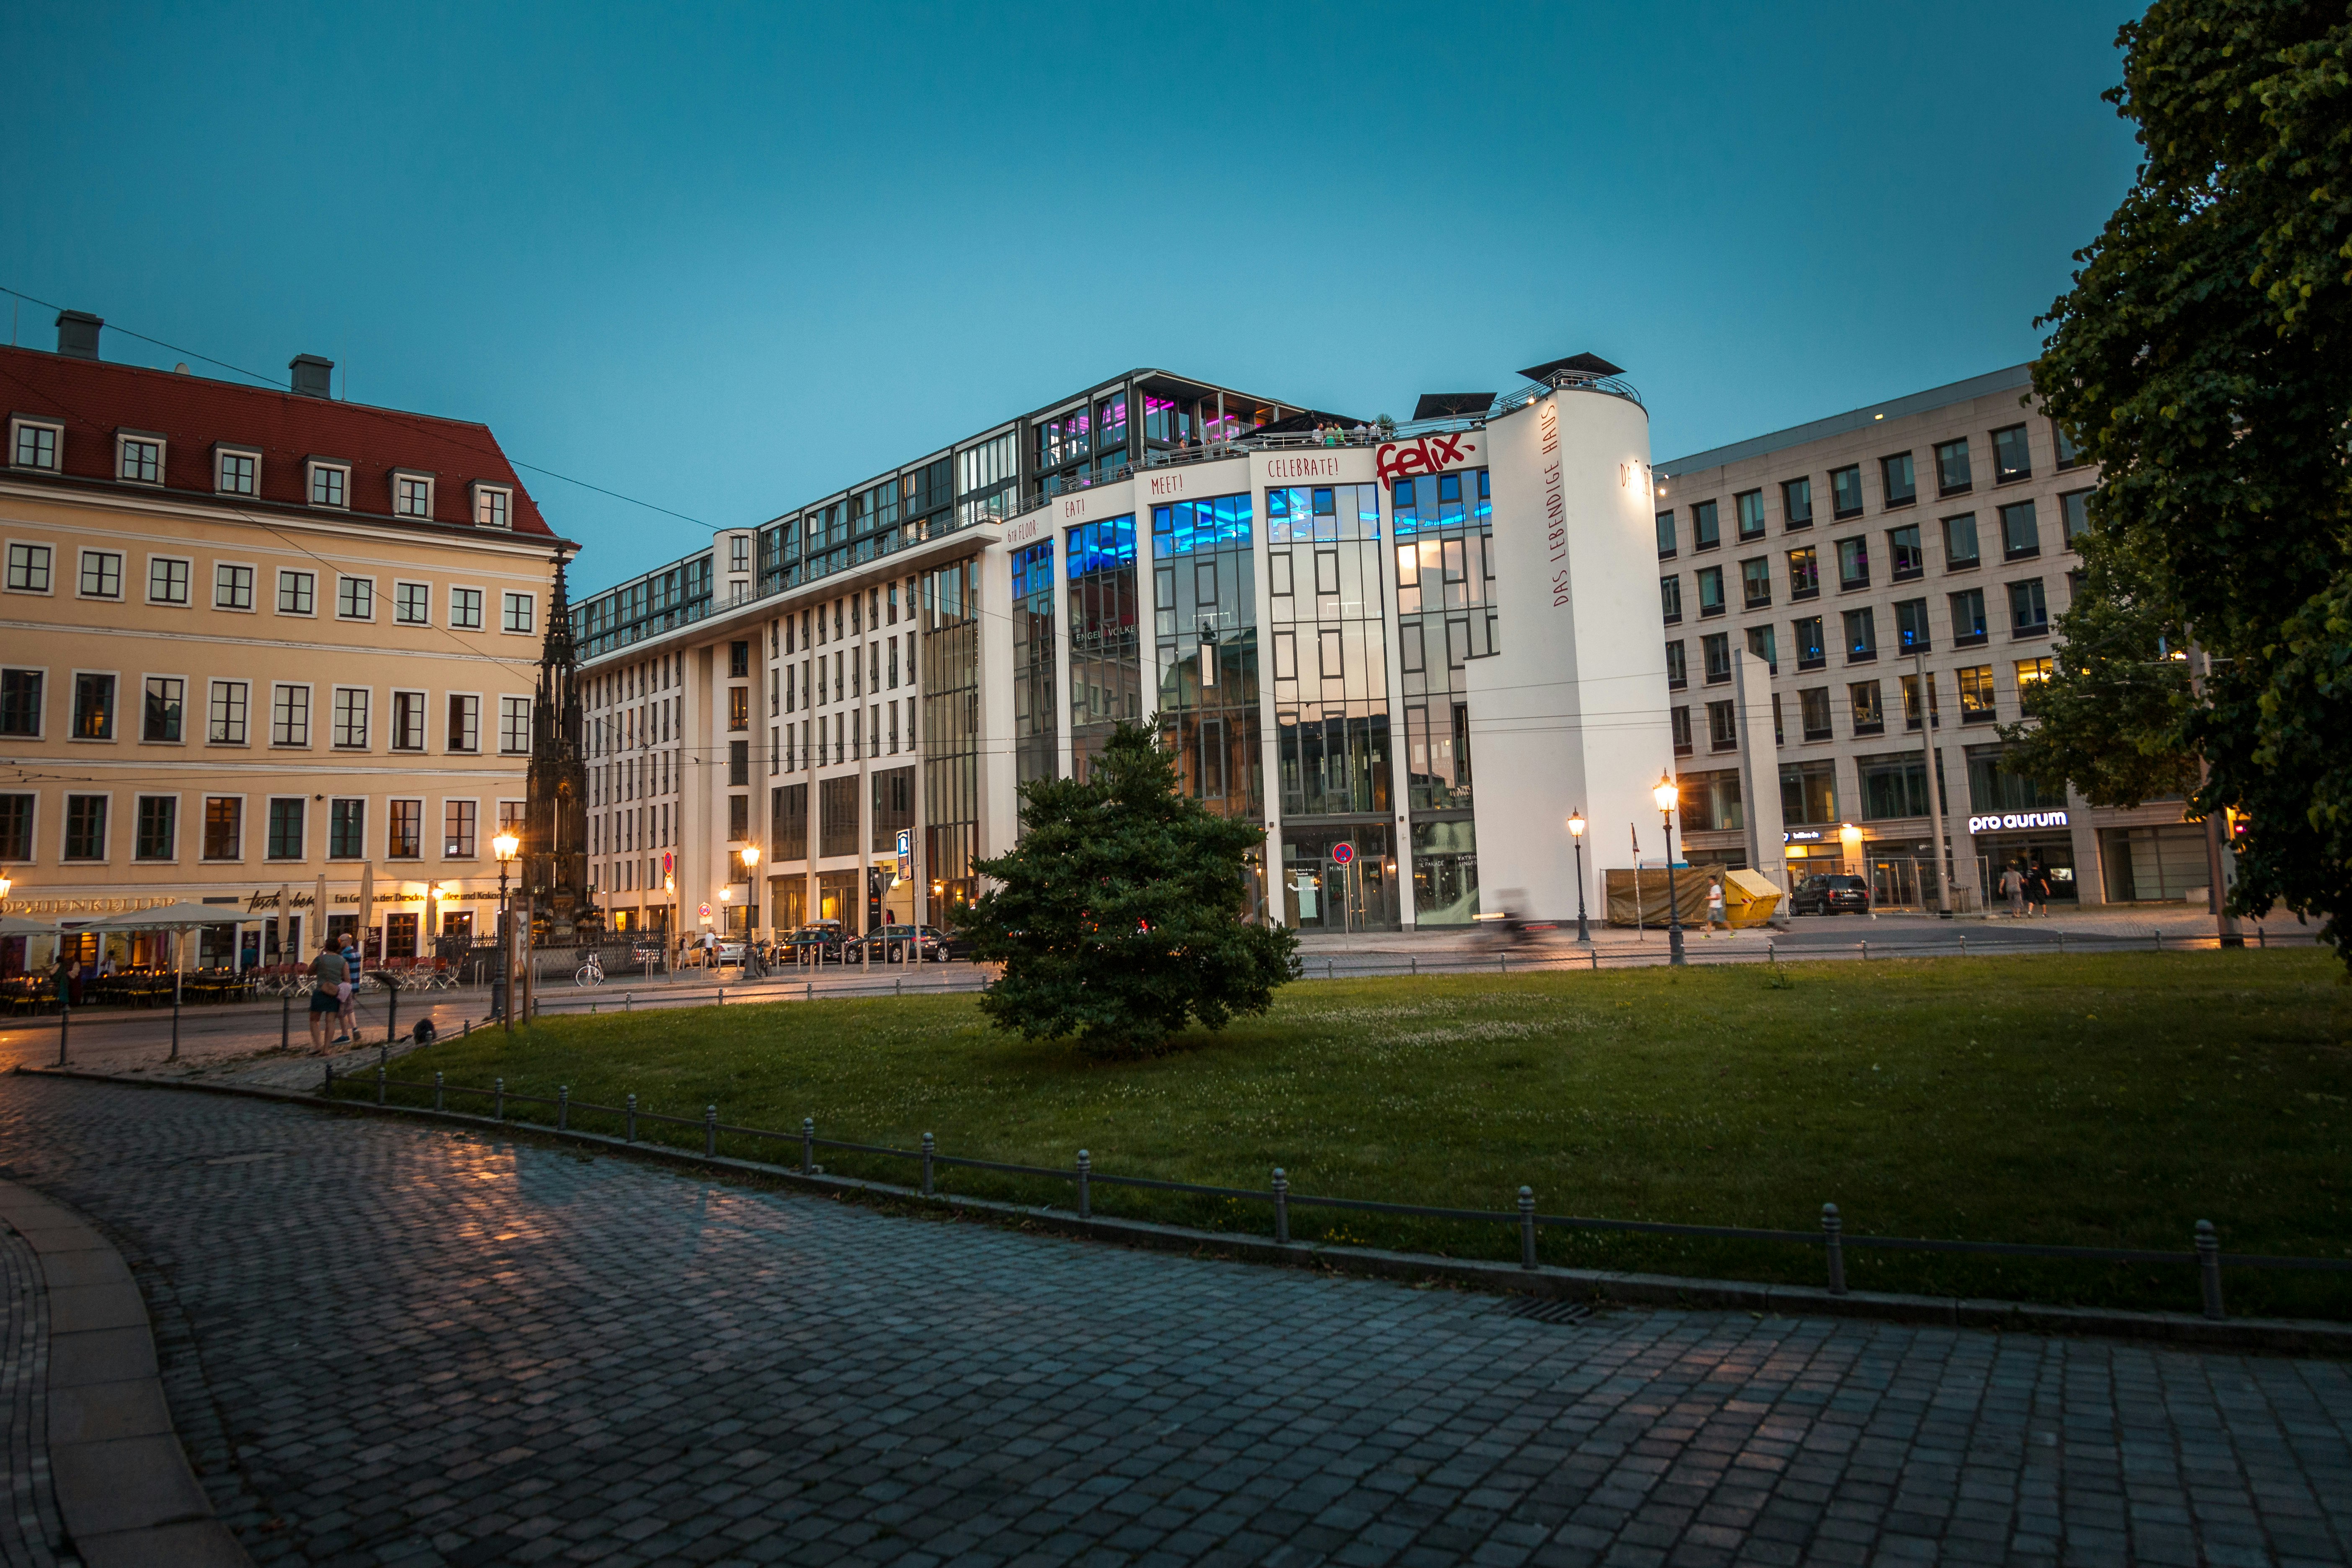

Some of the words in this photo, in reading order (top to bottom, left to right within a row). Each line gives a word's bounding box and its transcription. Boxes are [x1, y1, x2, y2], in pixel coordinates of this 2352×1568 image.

[1541, 405, 1558, 454] HAUS
[1268, 457, 1338, 477] CELEBRATE!
[1151, 474, 1182, 495] MEET!
[1065, 498, 1084, 517] EAT!
[1545, 461, 1565, 562] LEBENDIGE
[1008, 529, 1017, 543] 6TH
[1019, 519, 1039, 540] FLOOR:
[1553, 570, 1569, 607] DAS
[1969, 816, 2002, 834] pro
[2003, 812, 2068, 828] aurum
[335, 894, 347, 903] Ein
[350, 894, 378, 903] Gess
[380, 893, 393, 902] der
[395, 893, 427, 901] Dresdne
